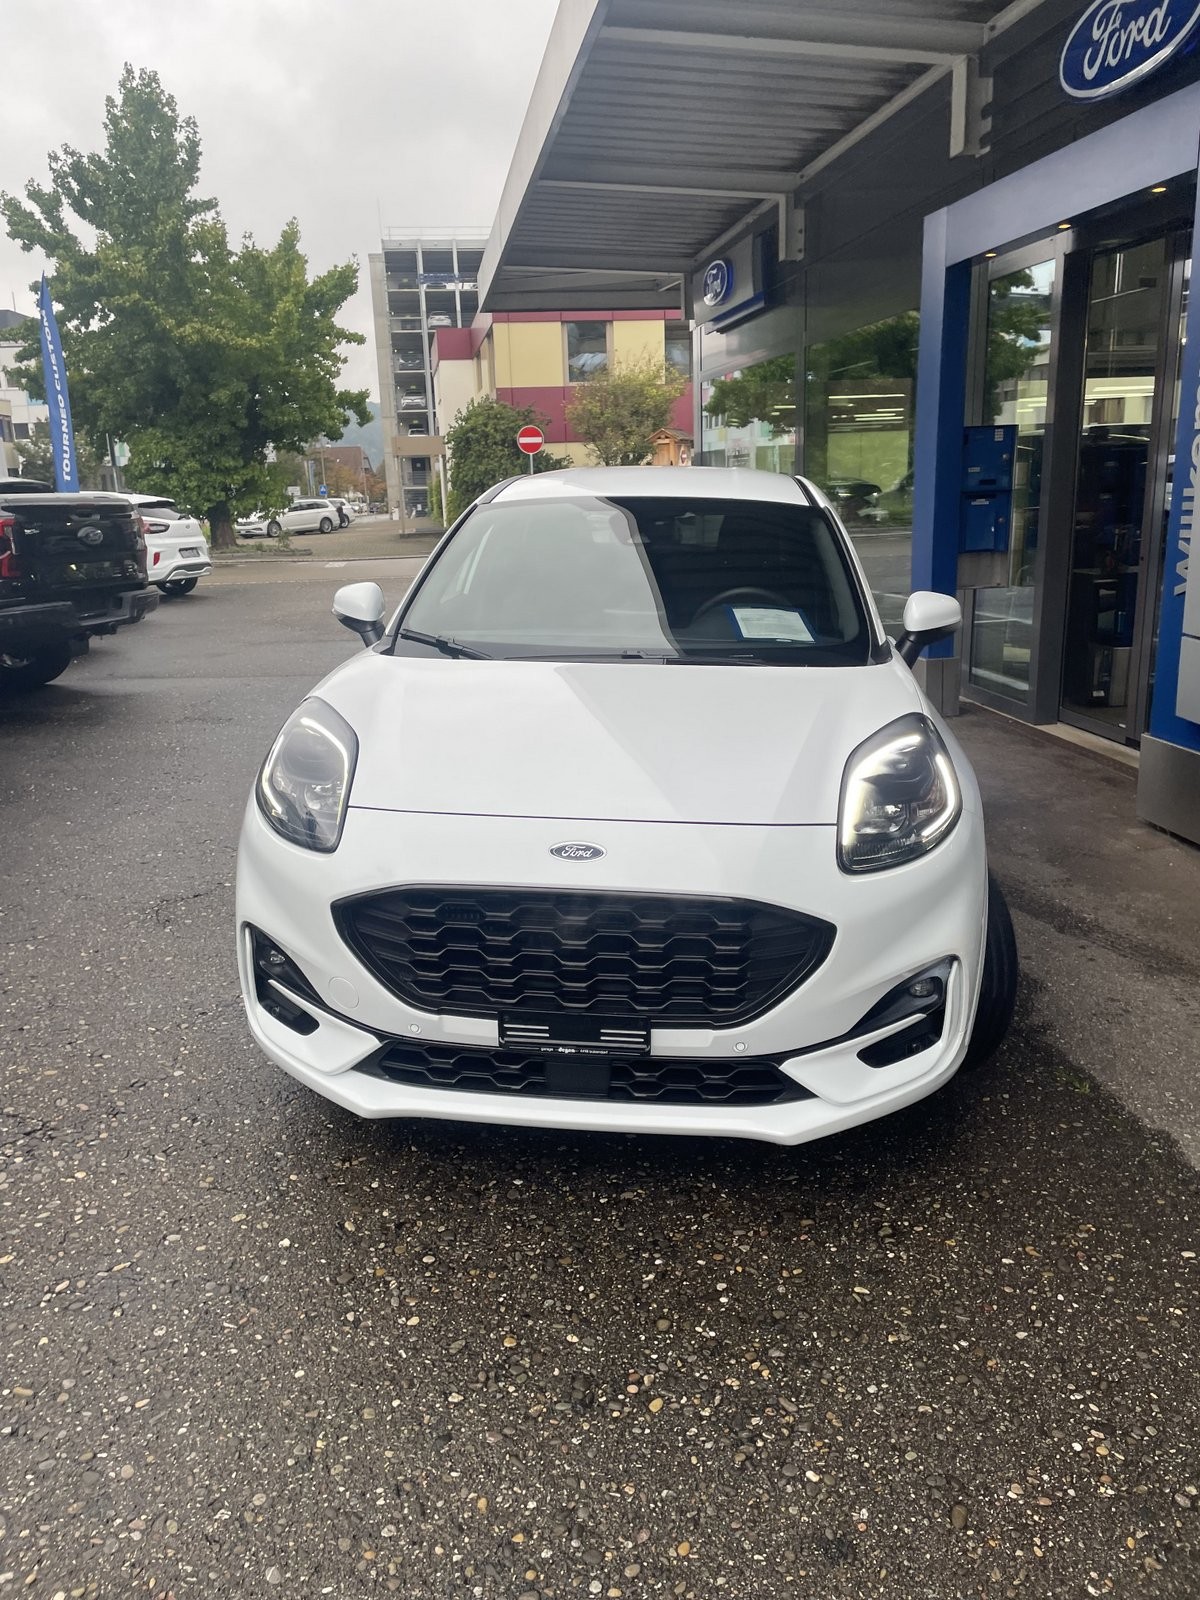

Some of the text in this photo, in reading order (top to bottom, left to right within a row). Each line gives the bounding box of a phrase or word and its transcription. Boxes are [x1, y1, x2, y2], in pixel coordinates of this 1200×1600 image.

[1083, 0, 1171, 80] Ford
[41, 309, 71, 481] TOURNEO CUSTOM
[561, 844, 594, 858] Ford
